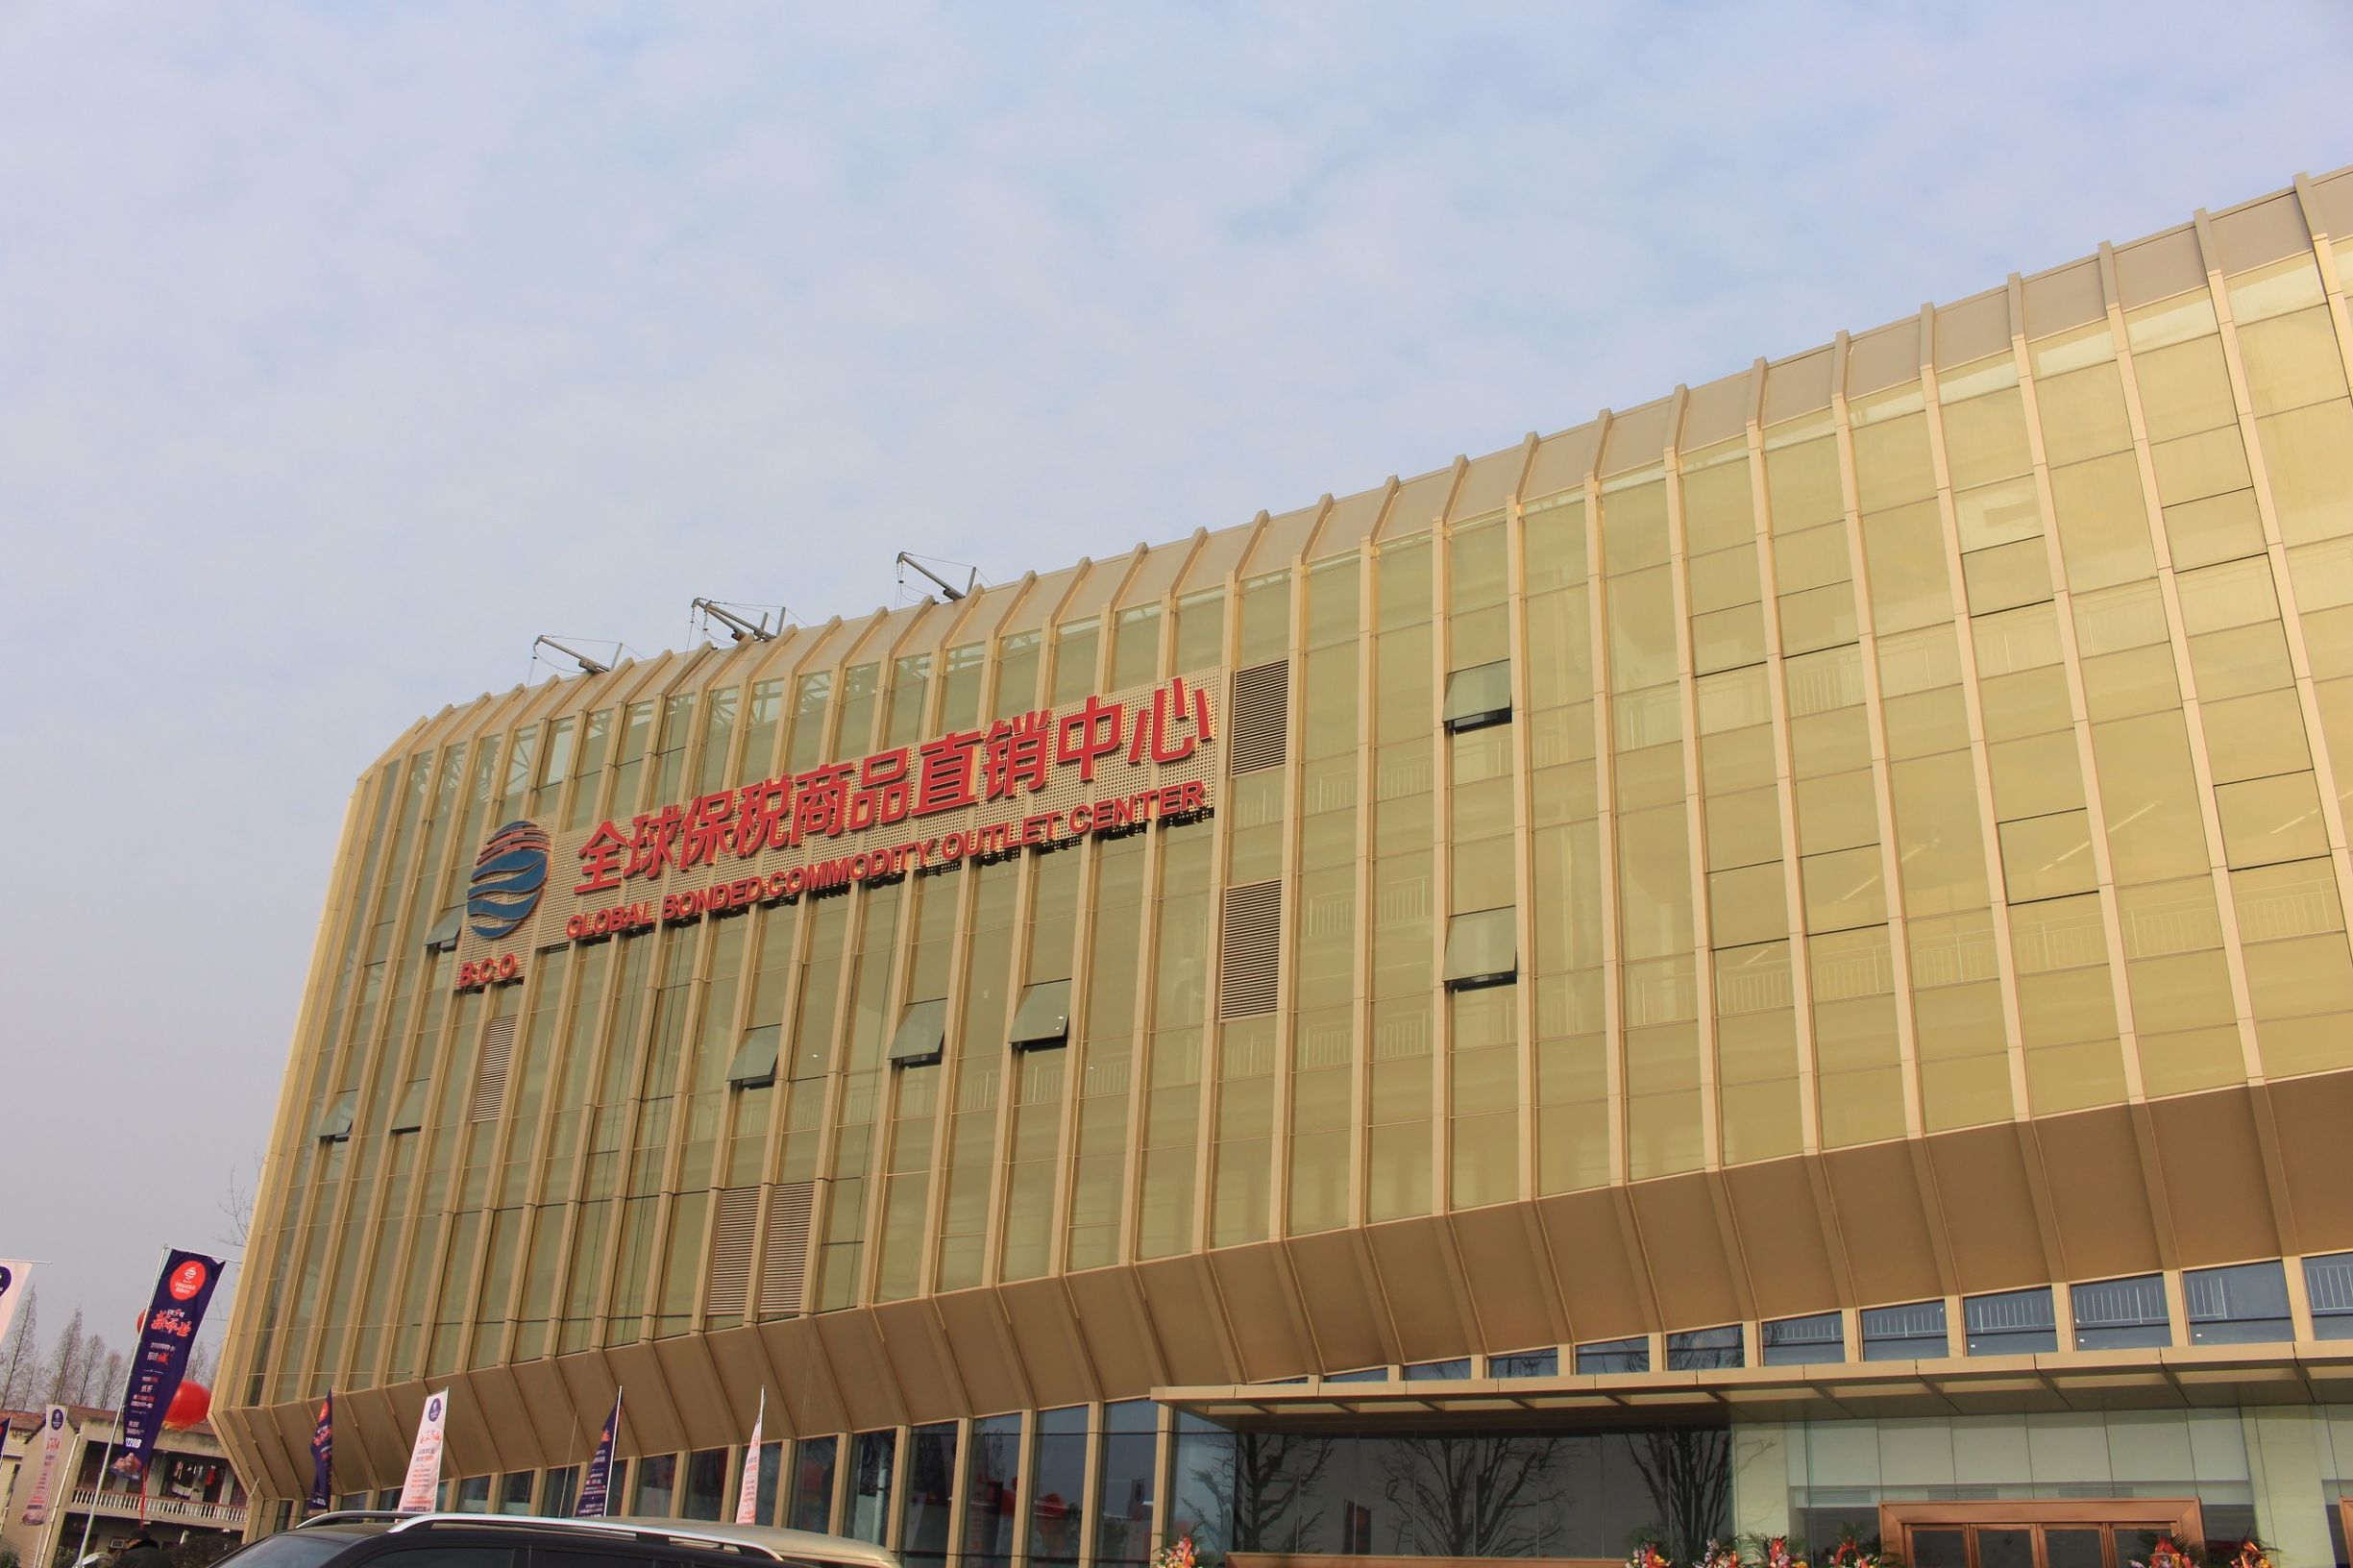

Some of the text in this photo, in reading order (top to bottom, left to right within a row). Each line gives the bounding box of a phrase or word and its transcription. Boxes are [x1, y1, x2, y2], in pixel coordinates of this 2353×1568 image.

[566, 780, 1206, 939] GLOBAL BONDED COMMODITY OUTLET CENTER
[575, 677, 1212, 895] 全球保税商品直销中心
[459, 952, 518, 988] BCO
